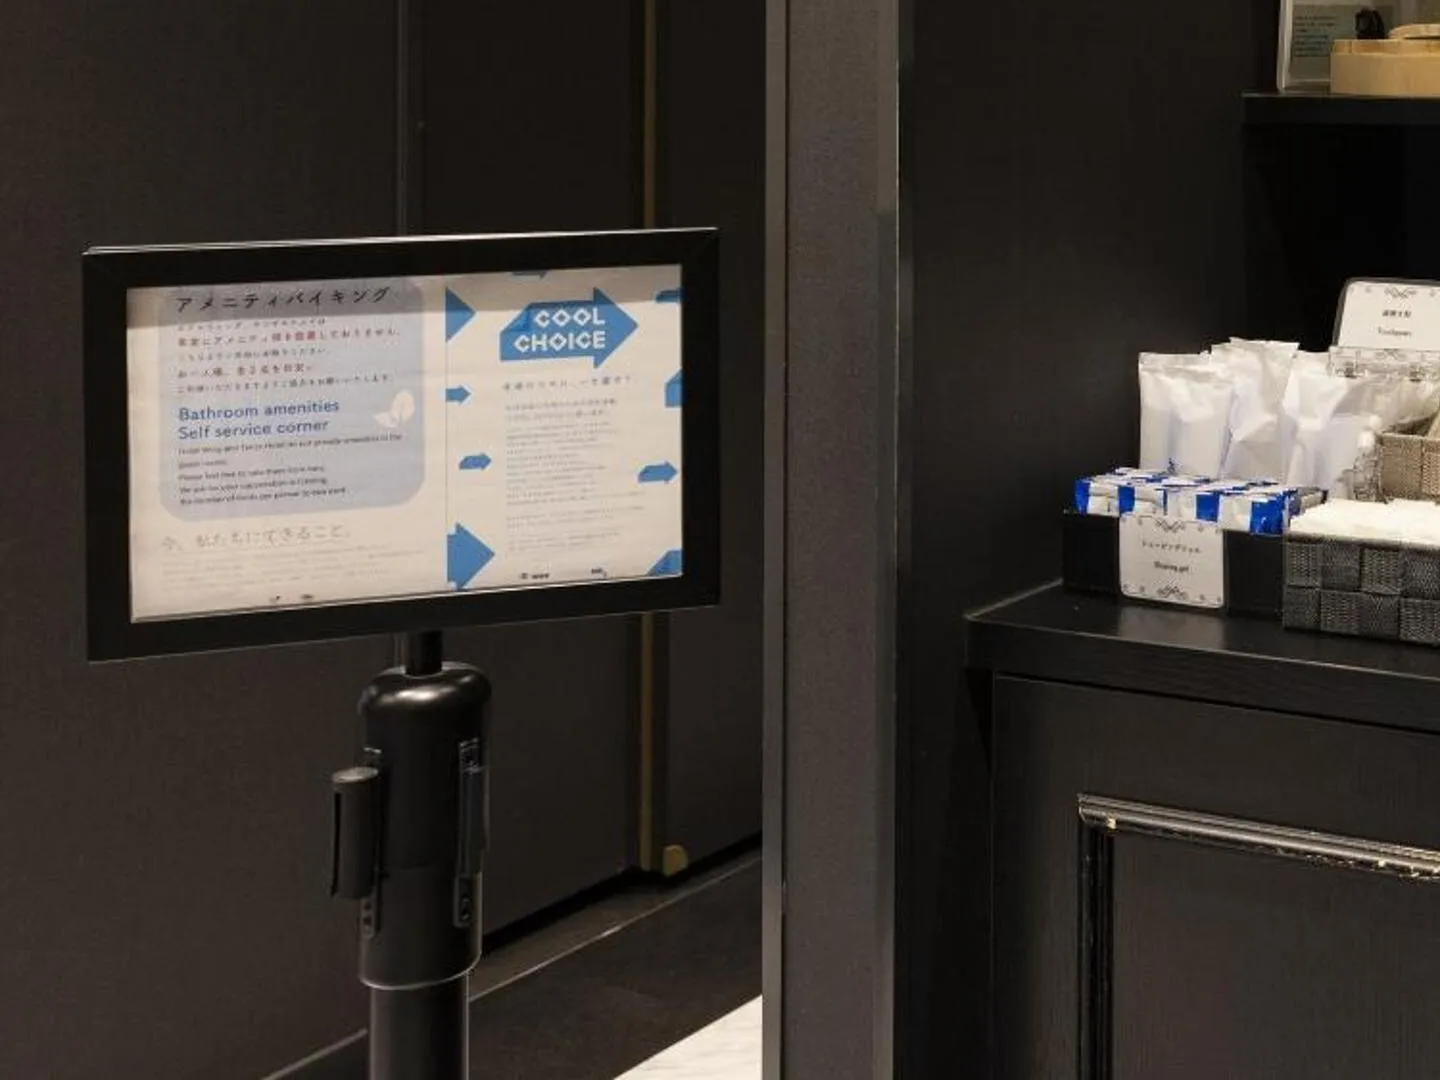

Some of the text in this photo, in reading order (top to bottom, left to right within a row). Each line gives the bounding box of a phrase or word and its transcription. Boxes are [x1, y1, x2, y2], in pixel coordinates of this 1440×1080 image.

[534, 307, 606, 328] COOL
[514, 330, 606, 353] CHOICE
[178, 400, 340, 422] Bathroom amenities
[178, 419, 330, 440] Self service corner
